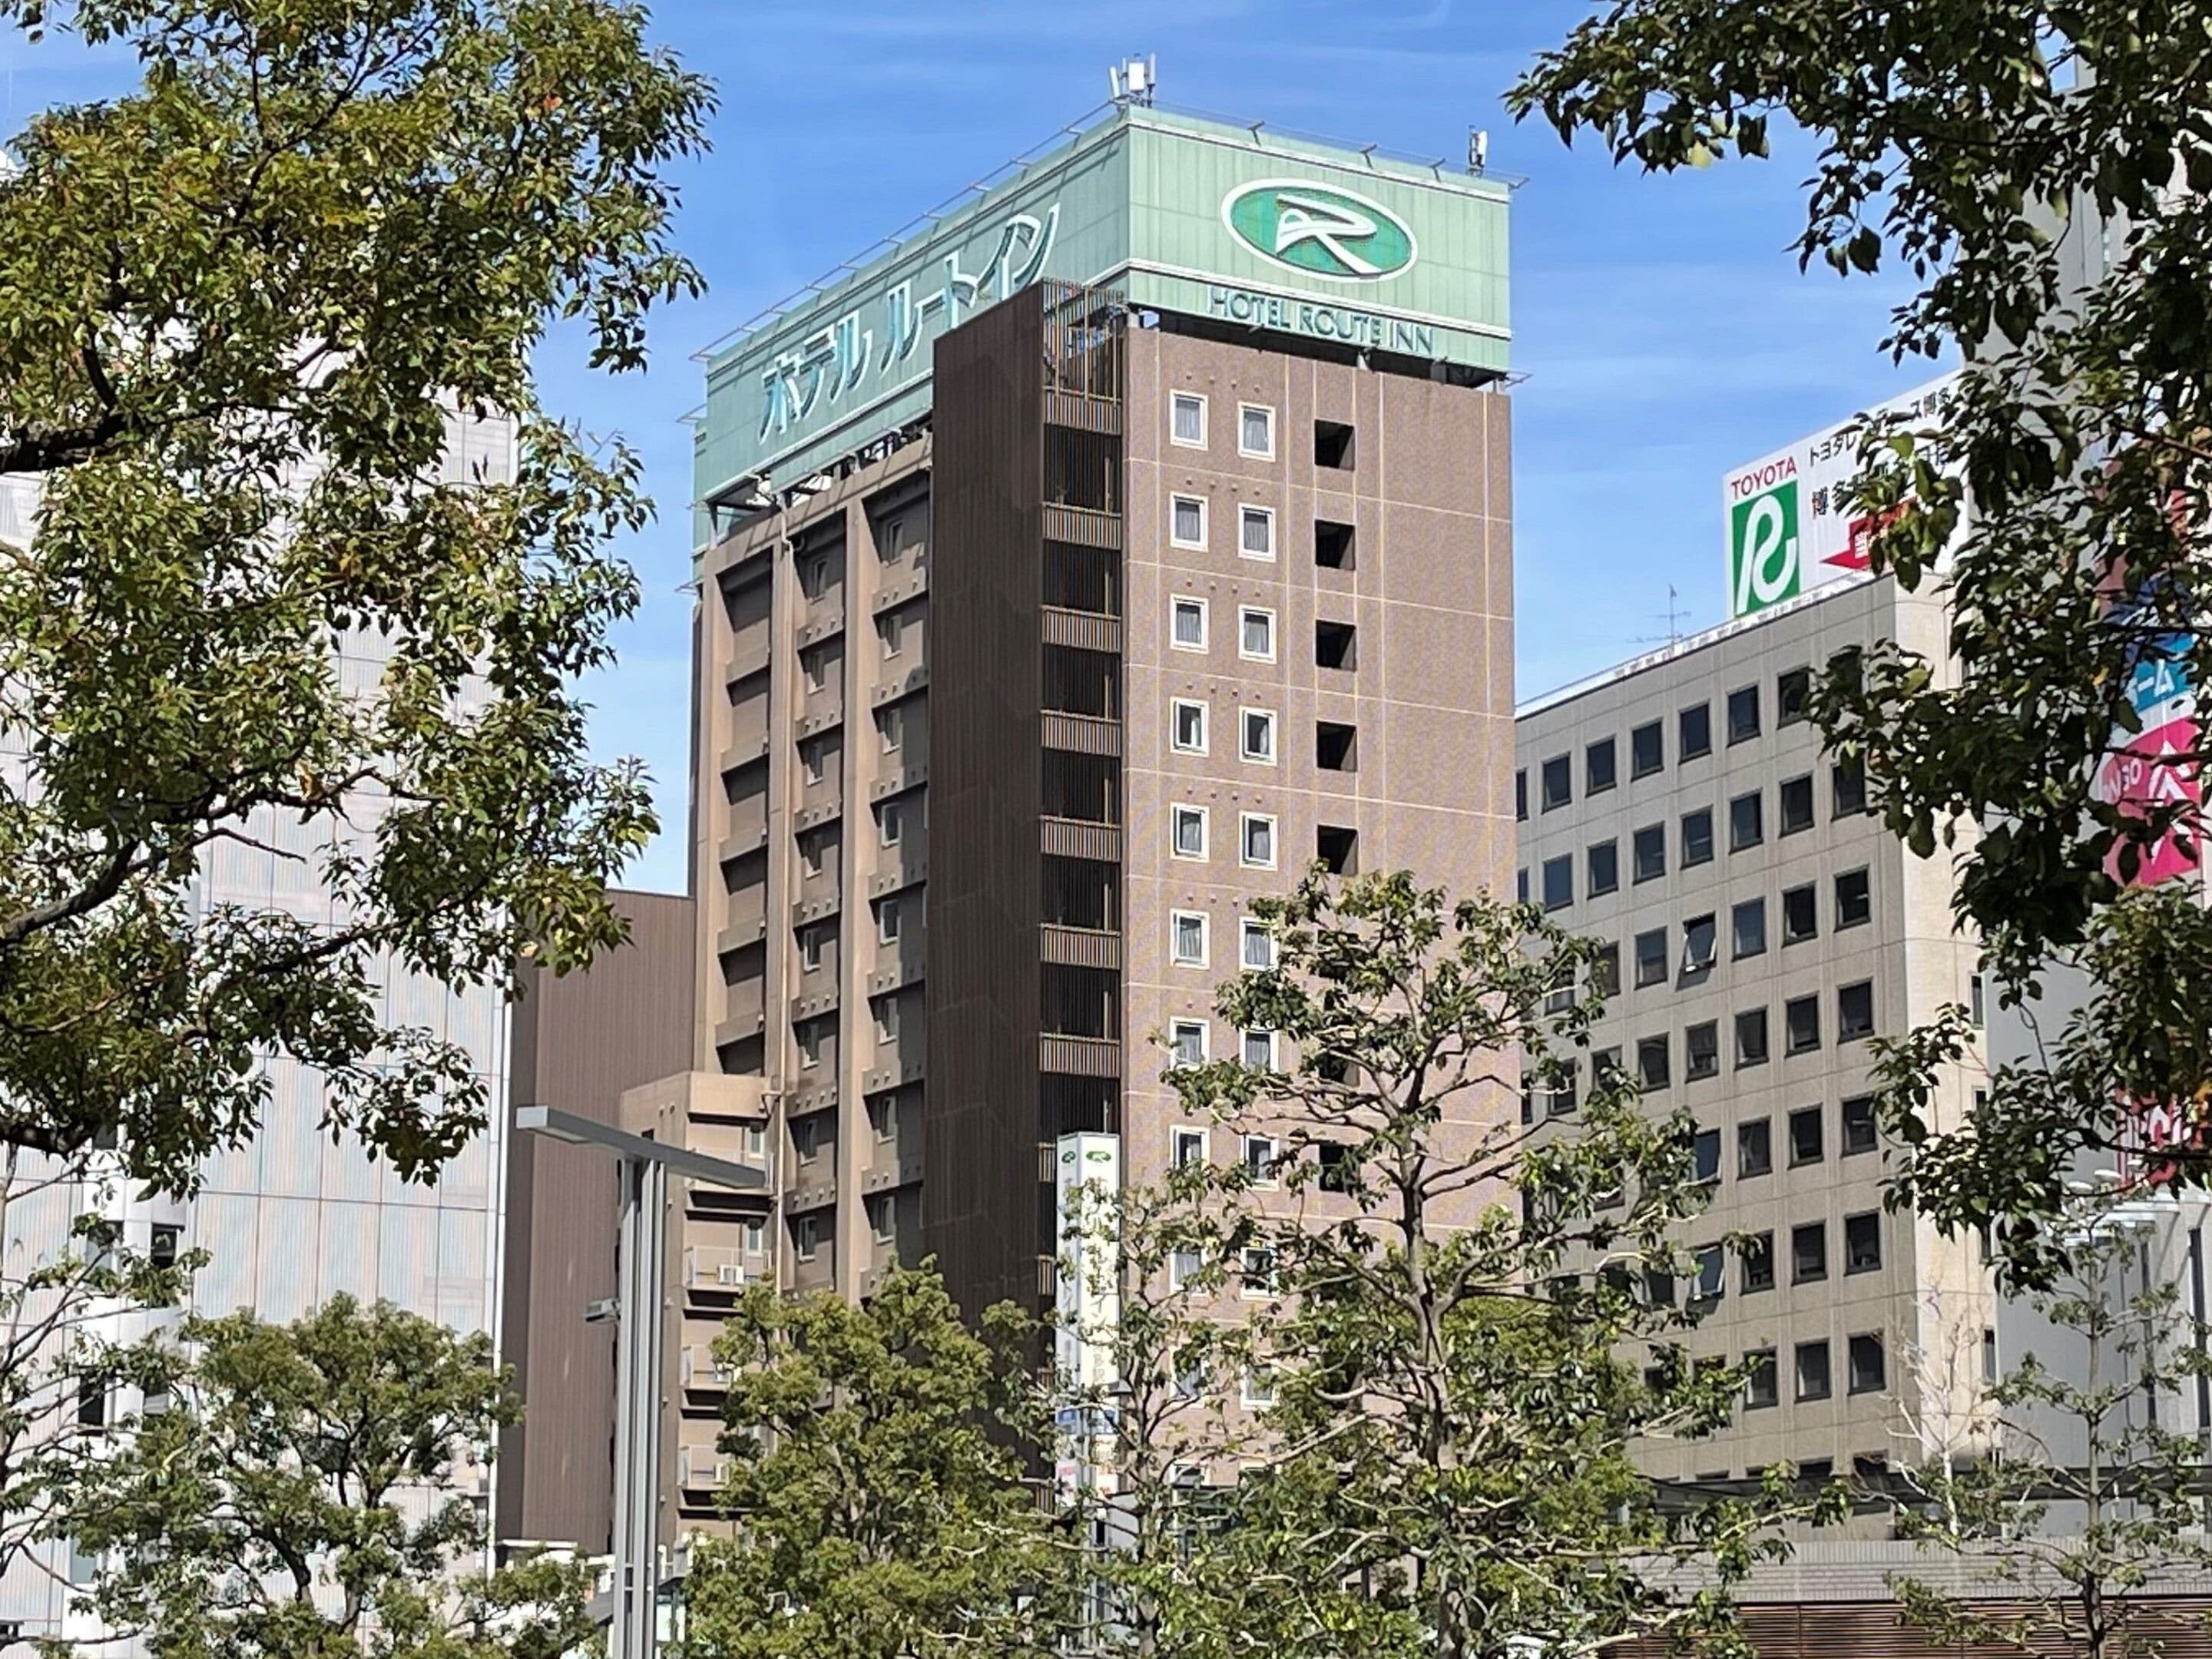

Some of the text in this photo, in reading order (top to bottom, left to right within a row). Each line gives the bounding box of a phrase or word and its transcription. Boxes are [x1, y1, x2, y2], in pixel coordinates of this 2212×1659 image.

[1207, 285, 1434, 355] HOTEL ROUTE INN
[1730, 455, 1797, 501] TOYOTA
